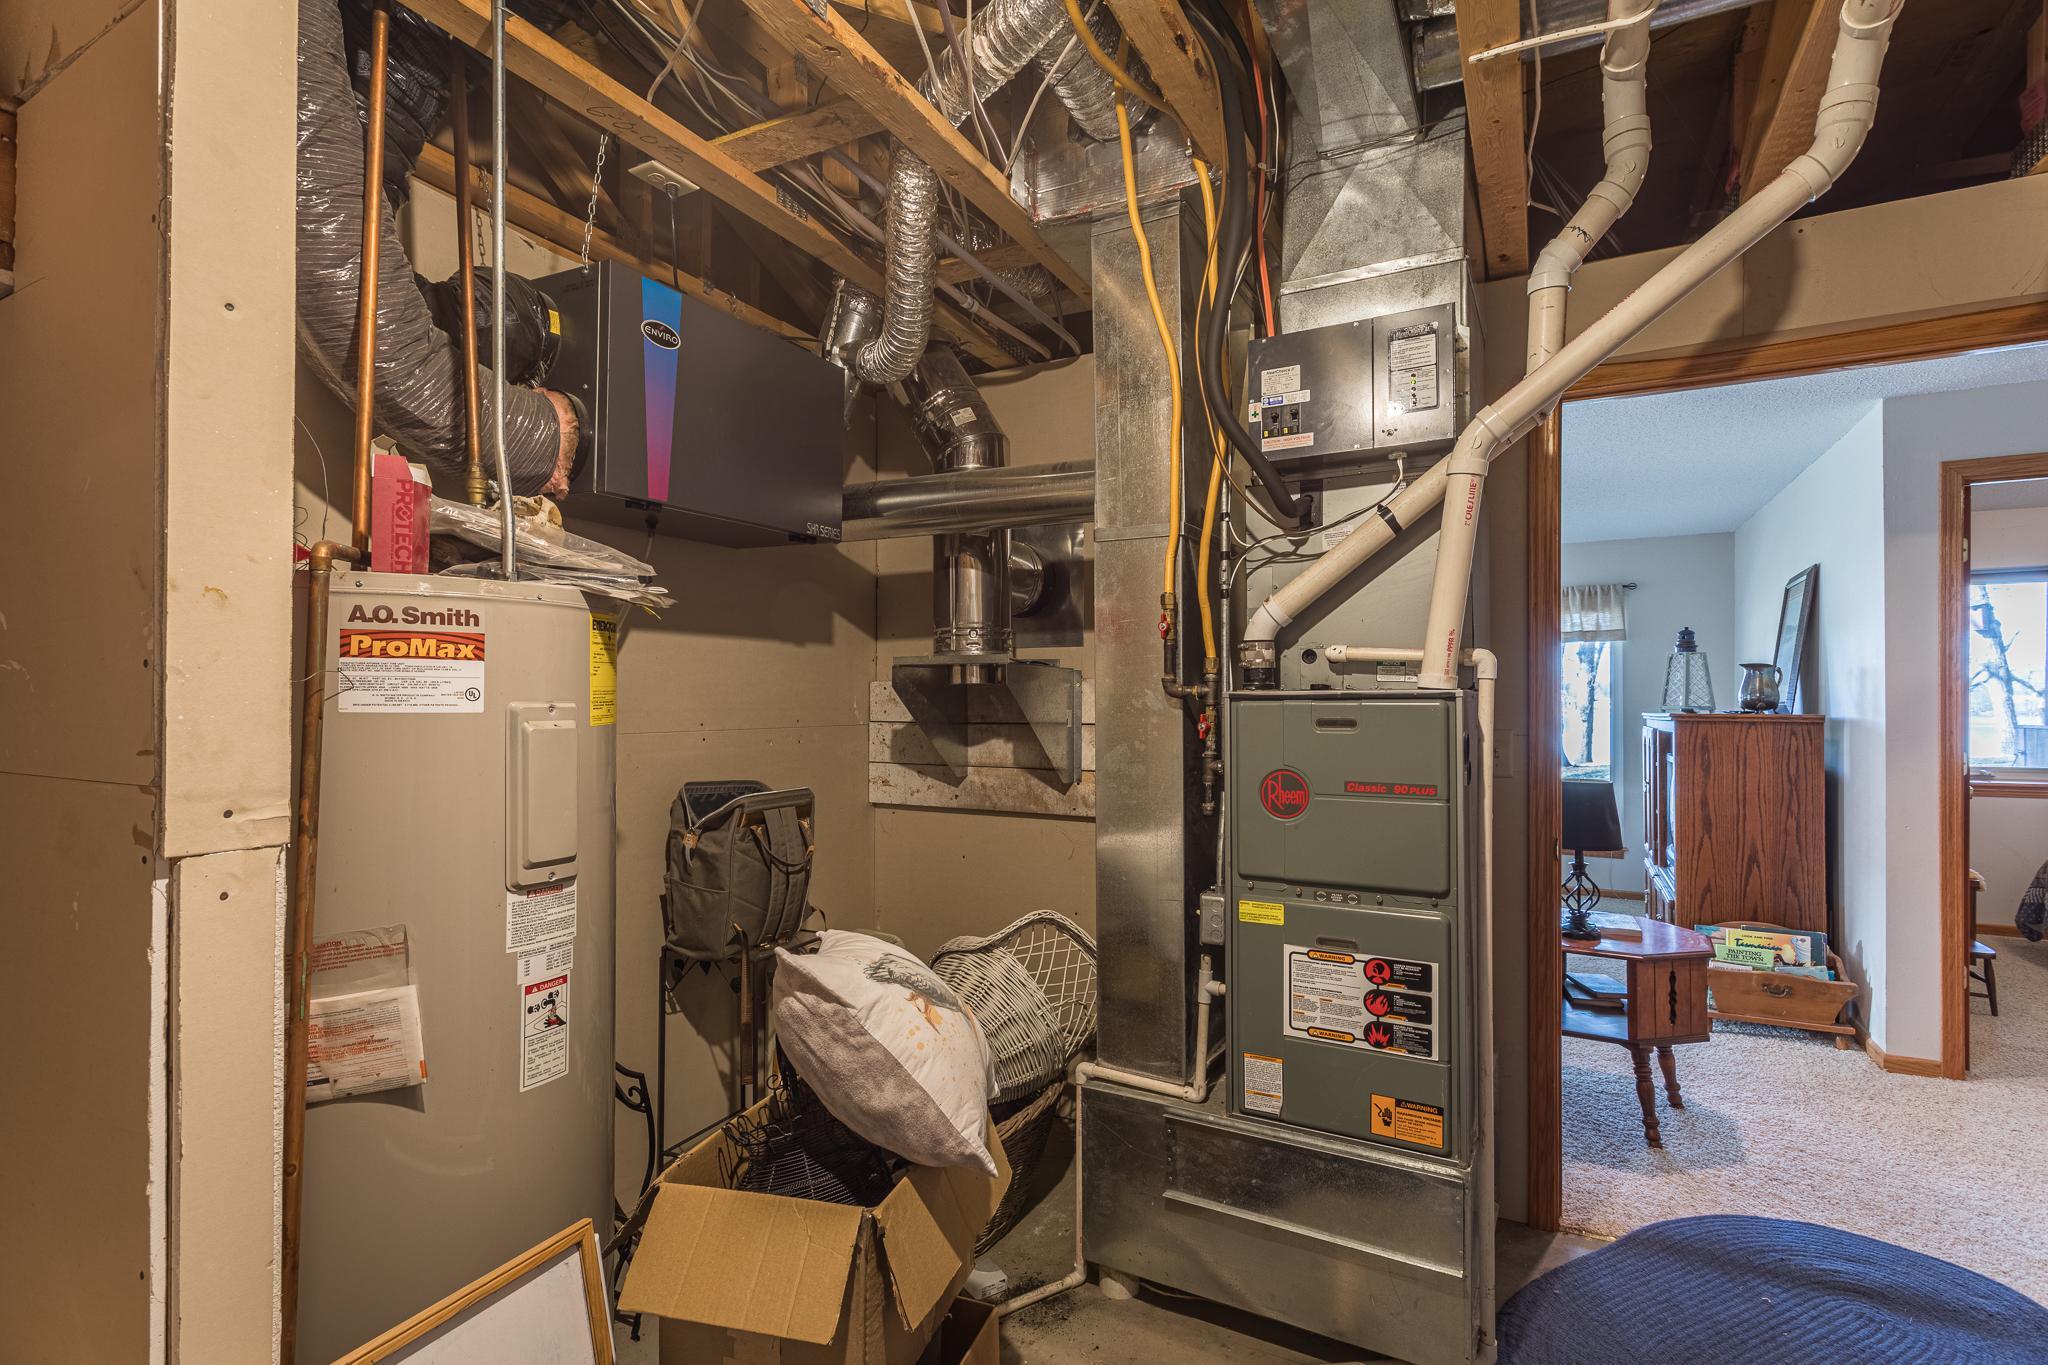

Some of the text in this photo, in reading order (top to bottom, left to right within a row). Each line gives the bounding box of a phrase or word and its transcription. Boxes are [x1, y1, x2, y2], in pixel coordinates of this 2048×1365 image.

[644, 325, 679, 345] ENVIRO
[395, 479, 413, 573] PROTECH
[820, 525, 841, 540] SERIES
[347, 604, 480, 627] A.O. Smith
[350, 634, 476, 659] ProMax
[1267, 775, 1305, 811] Rheem
[1346, 782, 1436, 796] Classic 90 PLUS
[1318, 953, 1346, 962] WARNING
[1727, 948, 1762, 957] PAINTING
[1741, 954, 1764, 962] TOWN
[539, 977, 564, 992] DANGER
[1318, 1031, 1346, 1040] WARNING
[1406, 1102, 1438, 1114] WARNING
